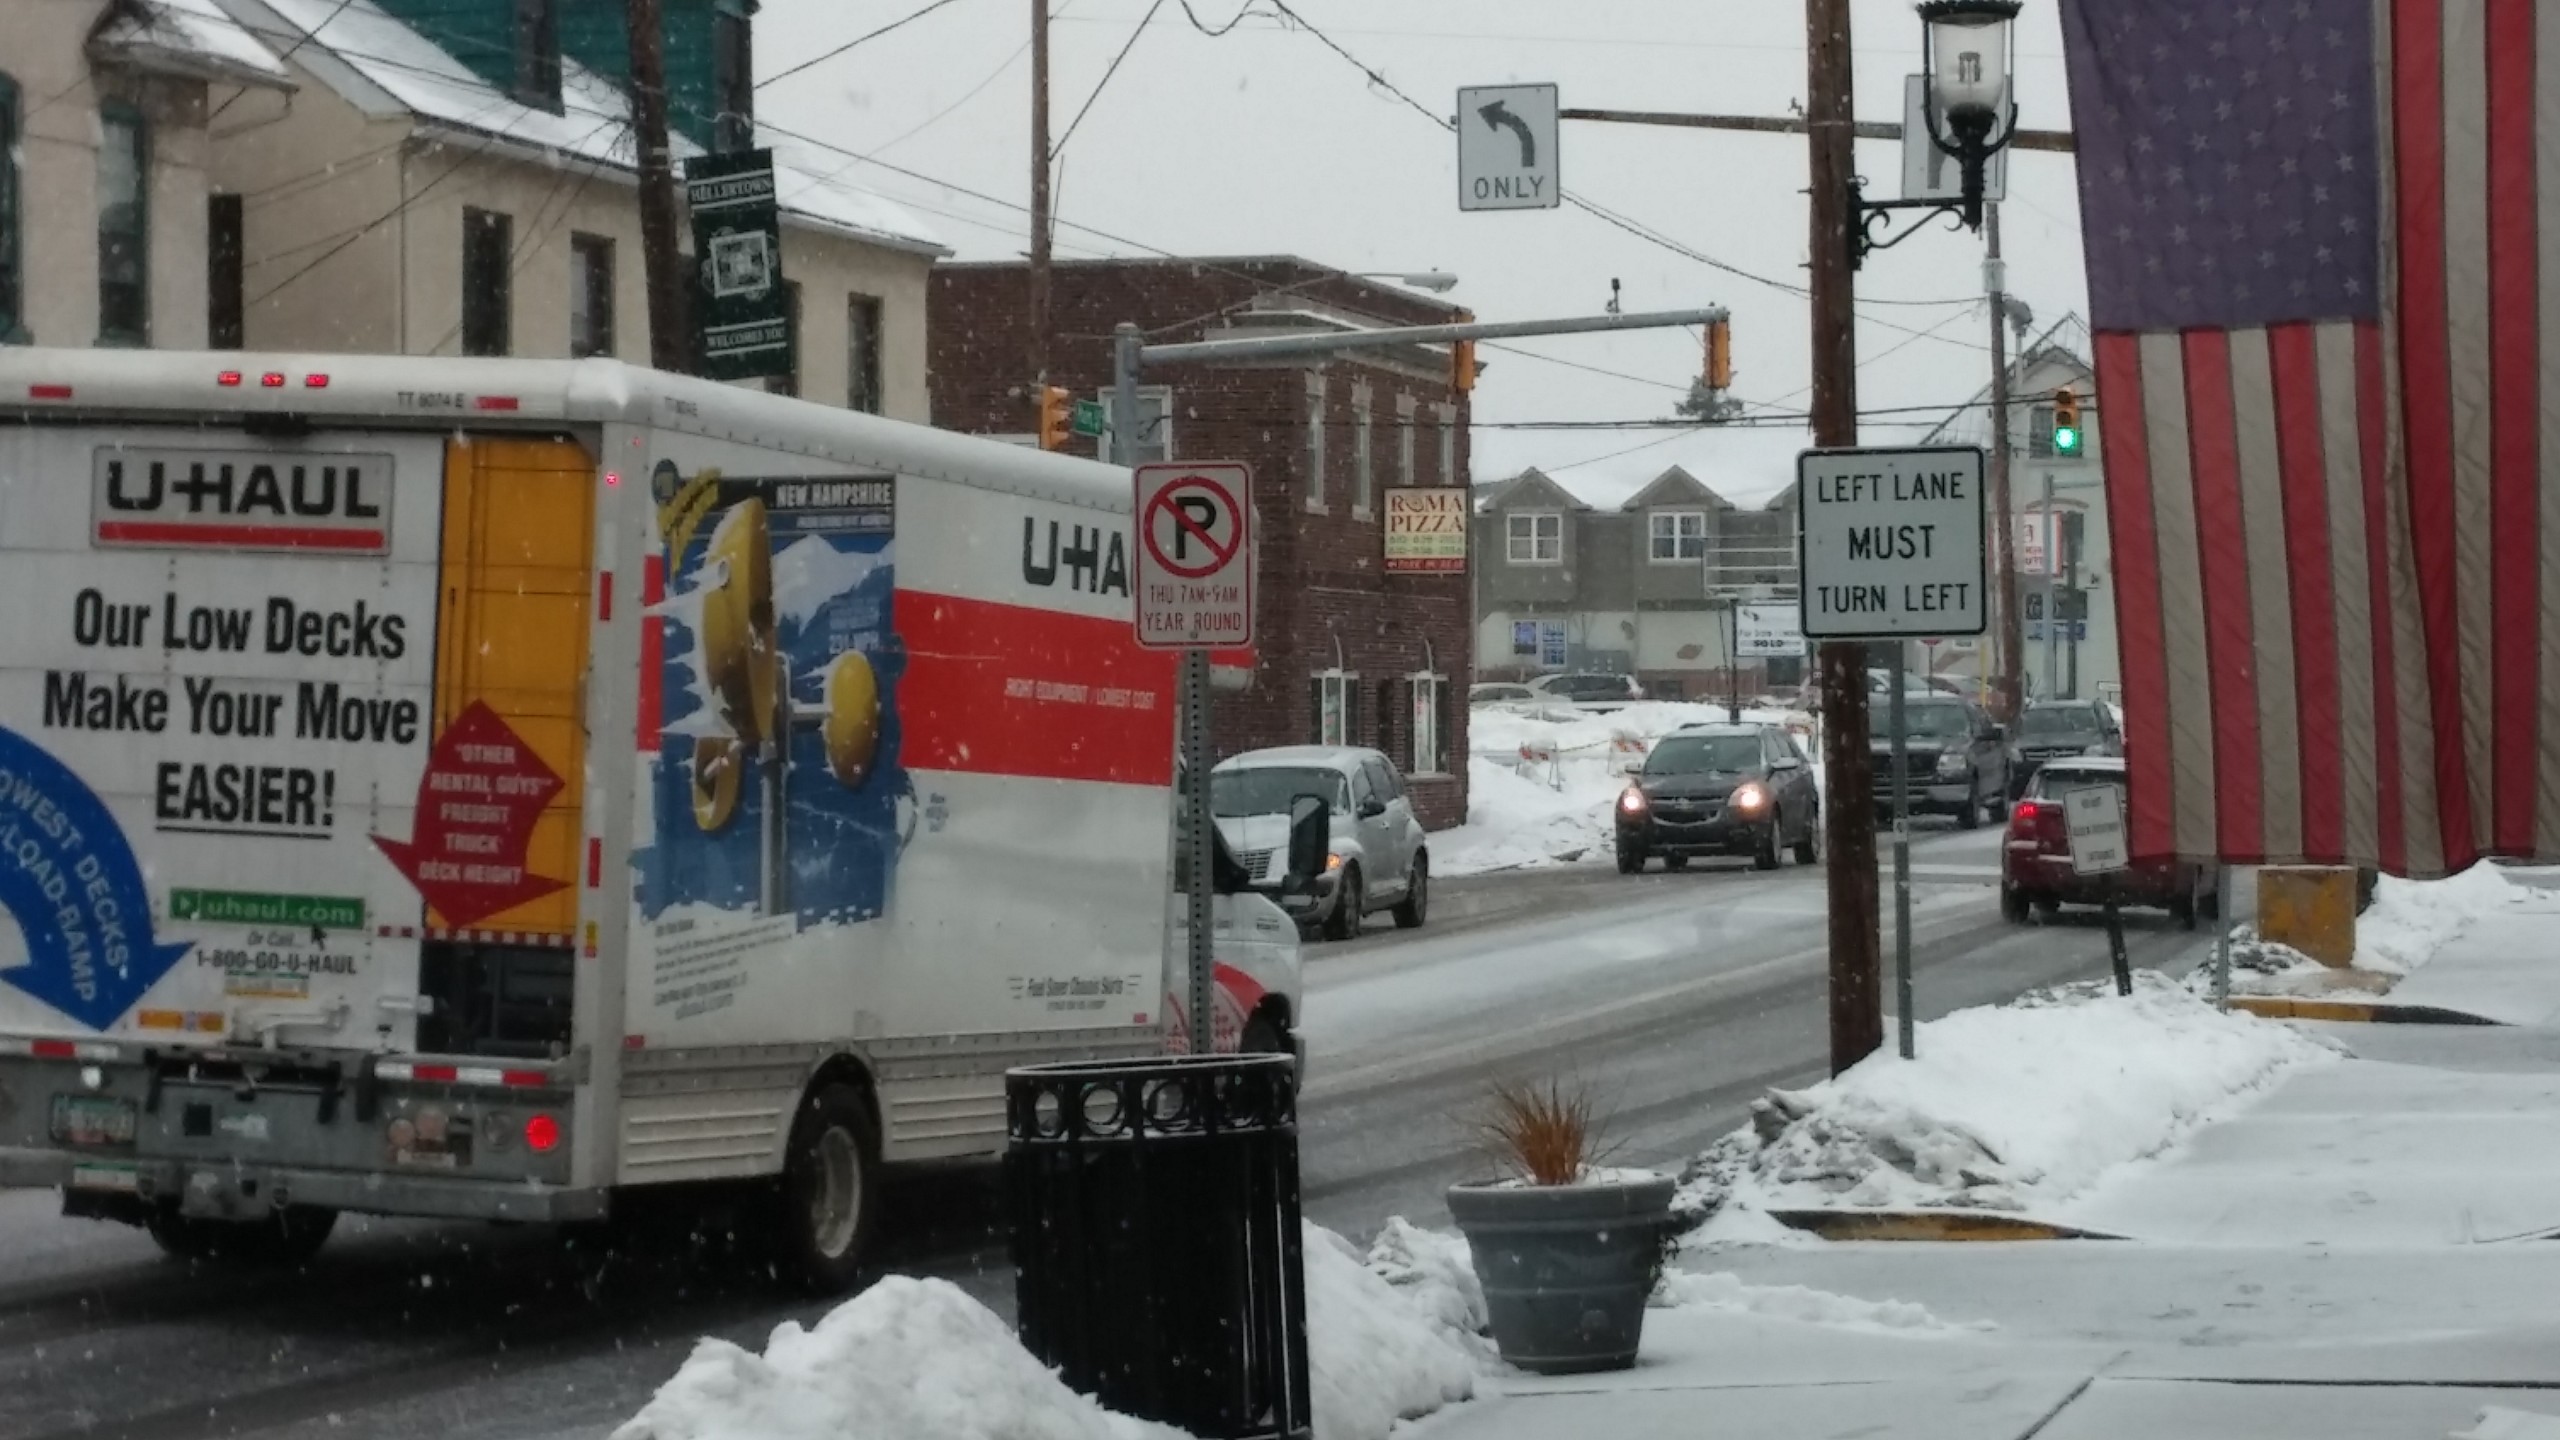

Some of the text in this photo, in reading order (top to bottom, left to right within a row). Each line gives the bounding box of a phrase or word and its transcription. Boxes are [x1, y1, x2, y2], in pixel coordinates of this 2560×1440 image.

[691, 177, 772, 201] HELLERTOWN
[1474, 175, 1545, 200] ONLY
[106, 460, 381, 519] U-HAUL
[776, 482, 893, 508] NEW HAMPSHIRE
[1817, 472, 1965, 503] LEFT LANE
[1391, 494, 1463, 513] ROMA
[1390, 515, 1464, 533] PIZZA
[1848, 524, 1935, 560] MUST
[1023, 516, 1133, 598] U-HA
[1150, 584, 1239, 604] THU 7AM-9AM
[1817, 583, 1969, 613] TURN LEFT
[73, 587, 406, 660] Our Low Decks
[1145, 612, 1241, 631] YEAR ROUND
[1753, 639, 1784, 648] SOLD
[43, 669, 419, 745] Make Your Move
[156, 762, 335, 826] EASIER!
[440, 803, 510, 824] FREIGHT
[446, 833, 500, 853] TRUCK
[419, 861, 522, 884] DECK HEIGHT
[207, 898, 356, 924] uhaul.com
[196, 949, 357, 976] 1-800-GO-U-HAUL
